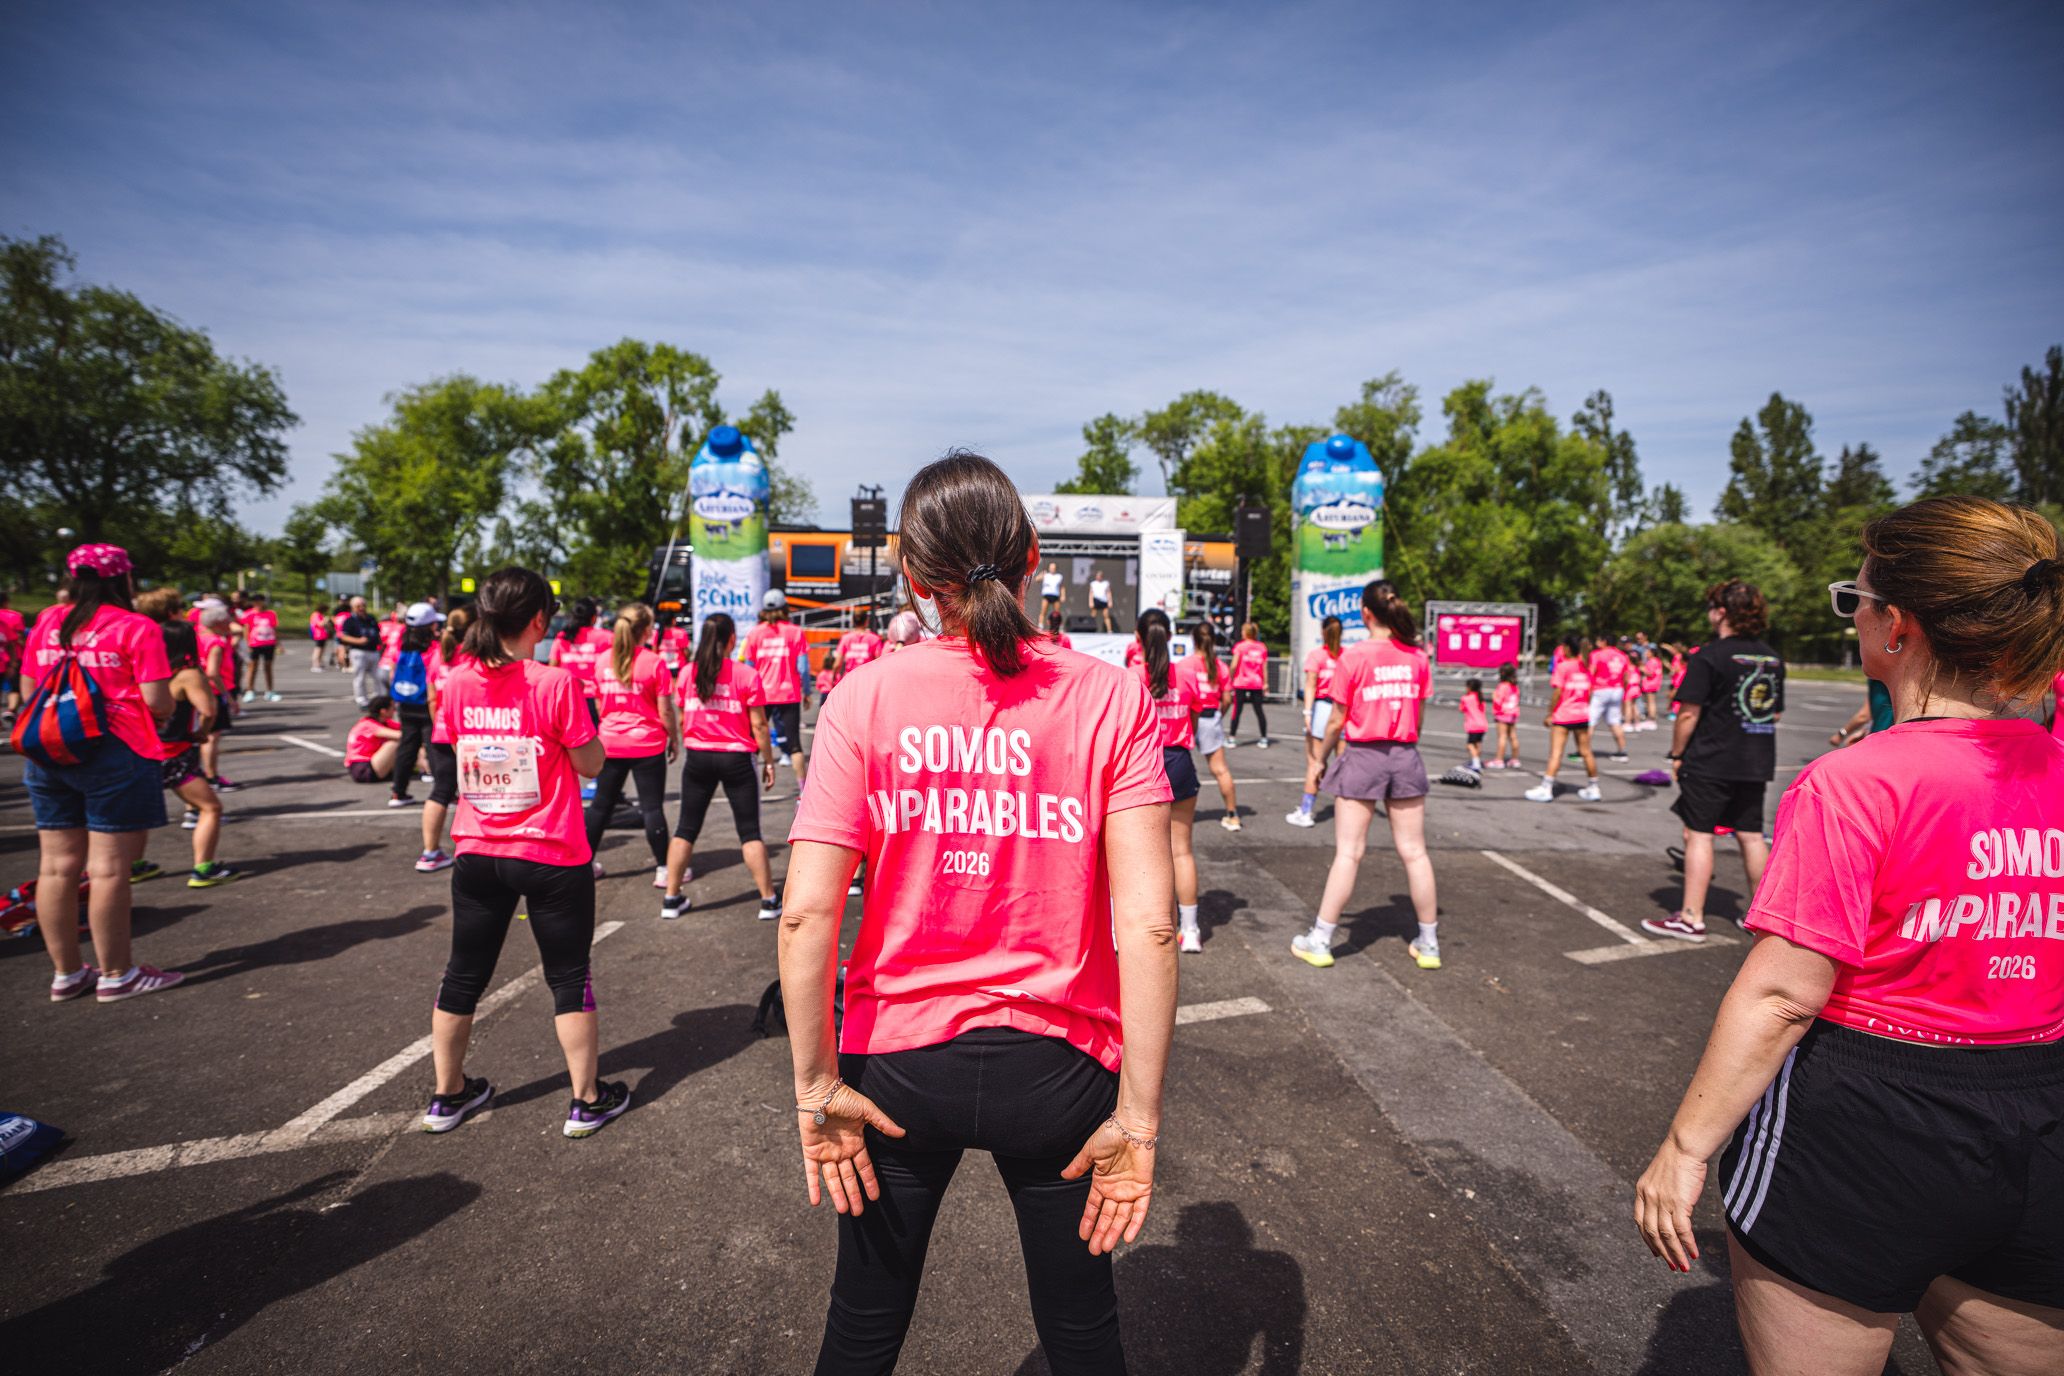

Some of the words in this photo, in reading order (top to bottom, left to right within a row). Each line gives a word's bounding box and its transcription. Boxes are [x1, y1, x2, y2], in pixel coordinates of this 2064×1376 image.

[1312, 591, 1364, 620] Calci
[463, 706, 521, 730] SOMOS
[898, 724, 1032, 777] SOMOS
[482, 773, 512, 786] 016
[866, 786, 1084, 844] IMPARABLES
[942, 850, 991, 877] 2026
[1987, 955, 2036, 980] 2026
